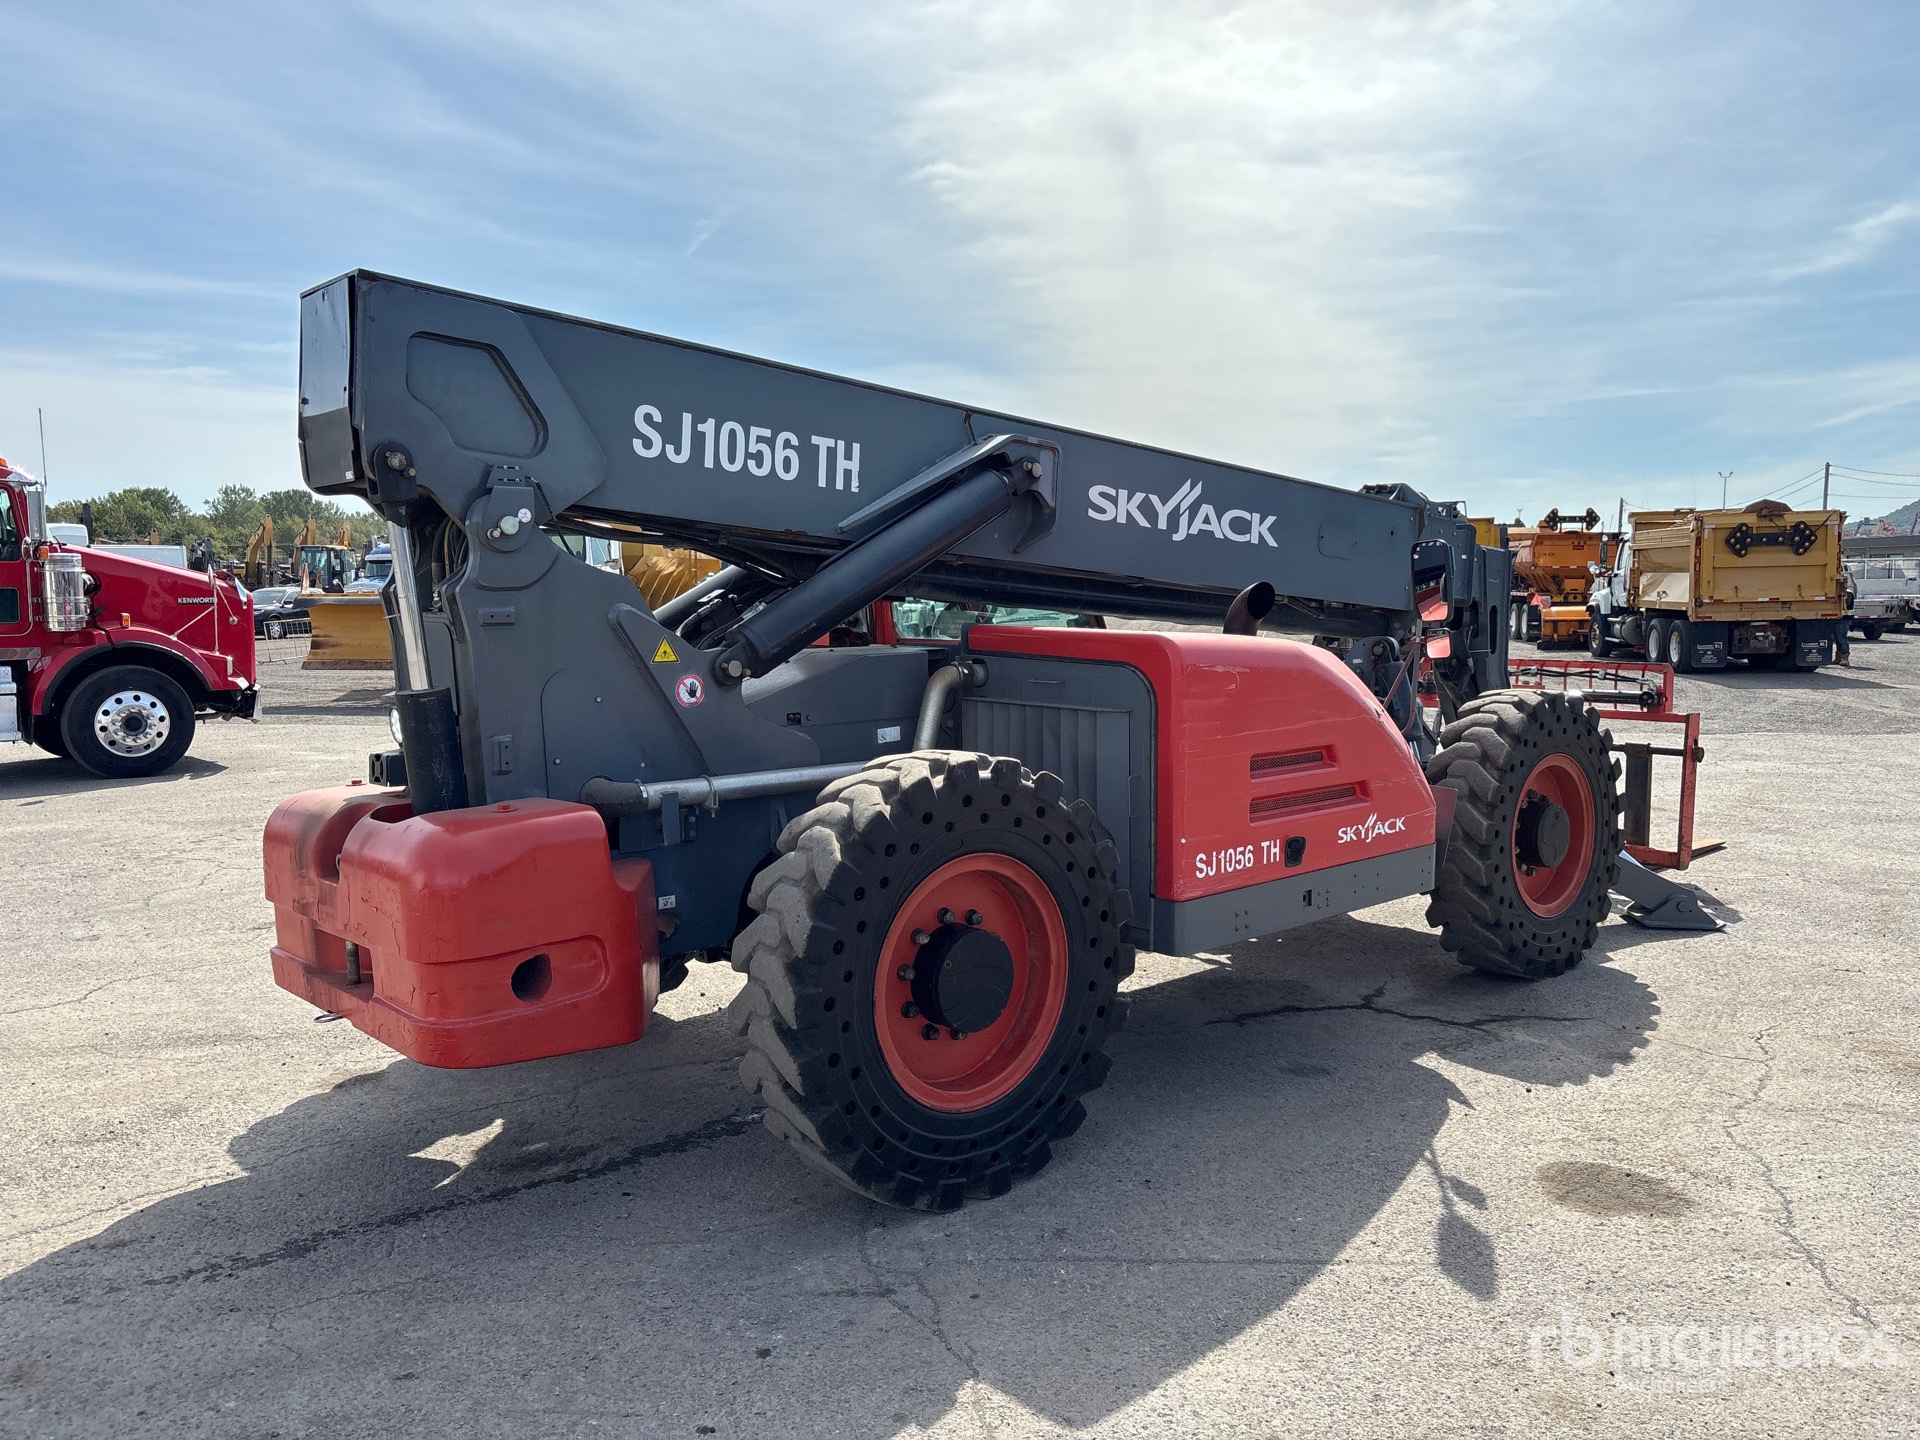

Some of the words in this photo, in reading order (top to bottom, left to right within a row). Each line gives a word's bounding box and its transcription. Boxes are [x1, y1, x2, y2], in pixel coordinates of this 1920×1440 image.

[632, 404, 800, 481] SJ1056
[811, 434, 861, 493] TH
[1087, 477, 1279, 548] SKYJACK
[1337, 811, 1406, 844] SKYJACK
[1195, 844, 1254, 879] SJ1056
[1260, 838, 1280, 865] TH
